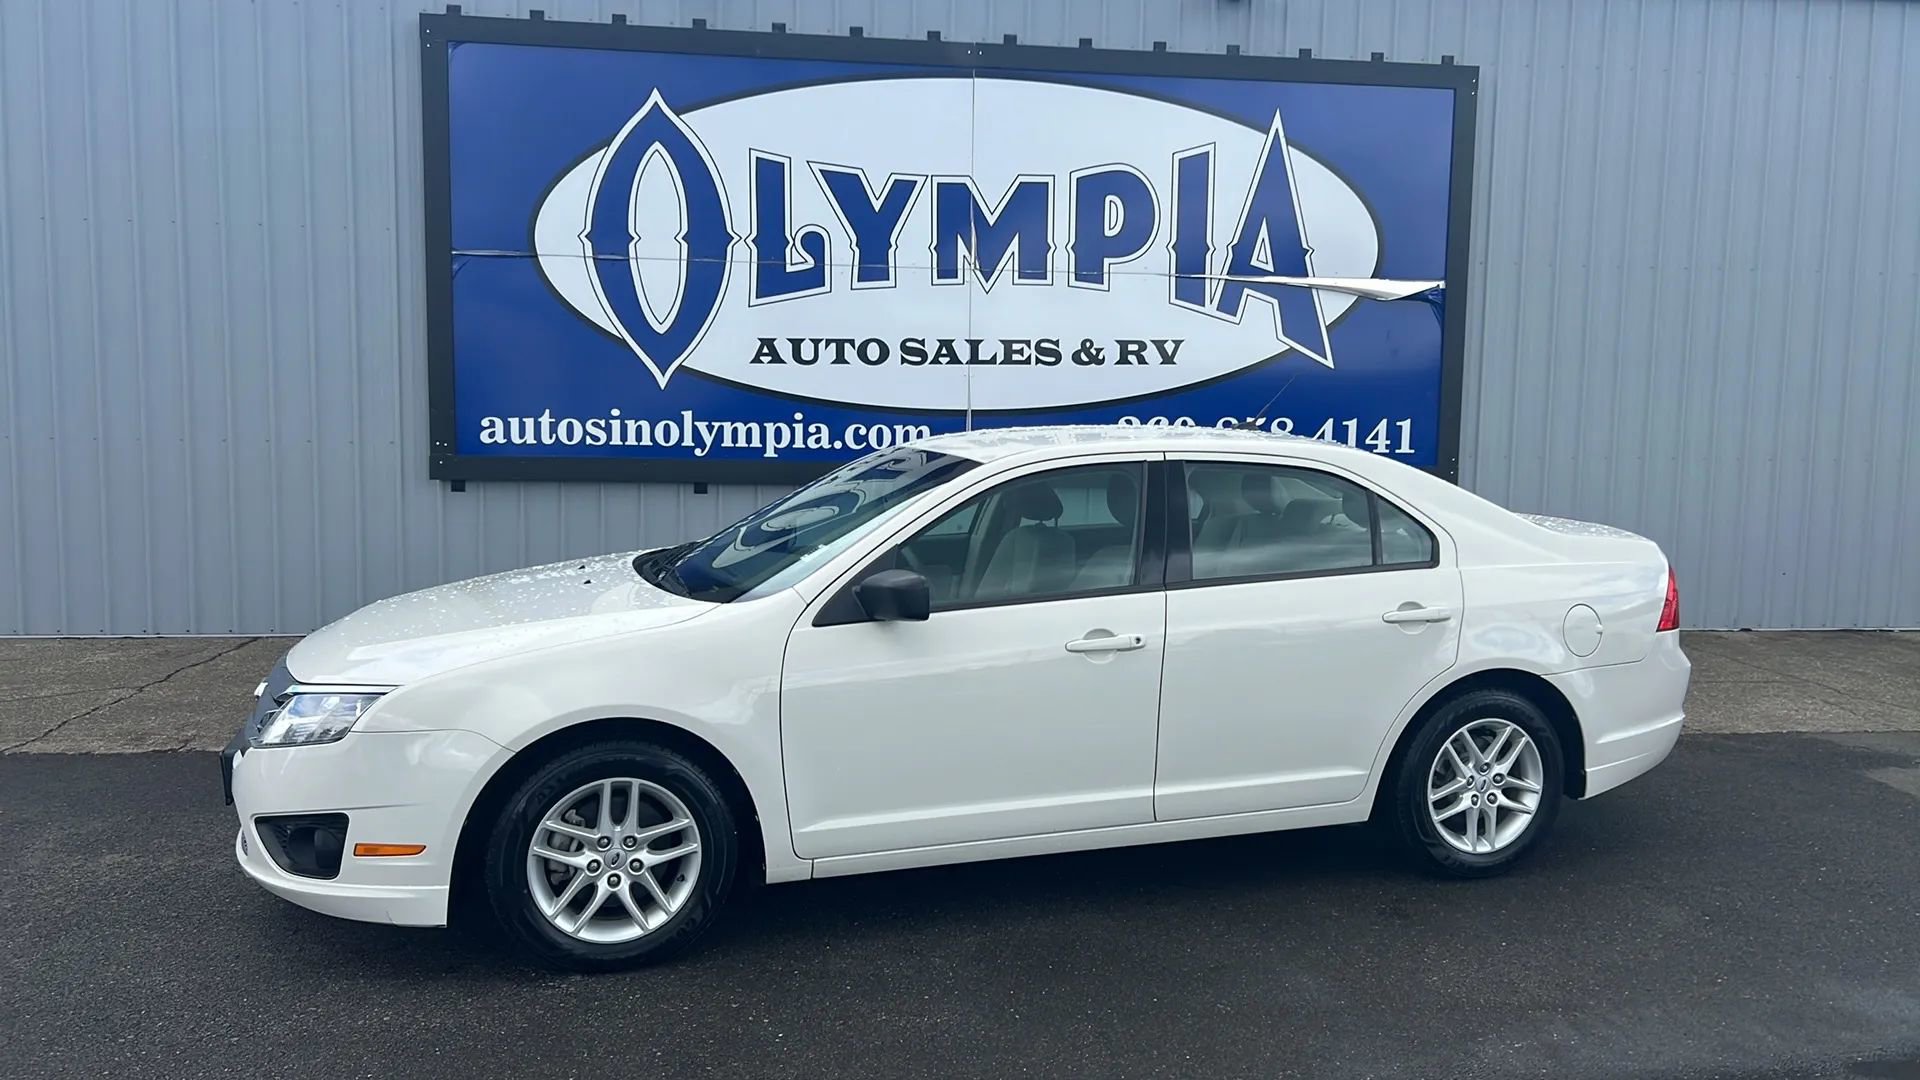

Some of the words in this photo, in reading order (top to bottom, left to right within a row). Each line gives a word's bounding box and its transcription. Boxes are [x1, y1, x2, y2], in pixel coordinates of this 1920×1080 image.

[577, 87, 1334, 390] OLYMPIA
[749, 338, 890, 365] AUTO
[900, 338, 1062, 366] SALES
[1071, 338, 1105, 366] &
[1113, 339, 1185, 365] RV
[479, 408, 931, 457] autosinolympia.com
